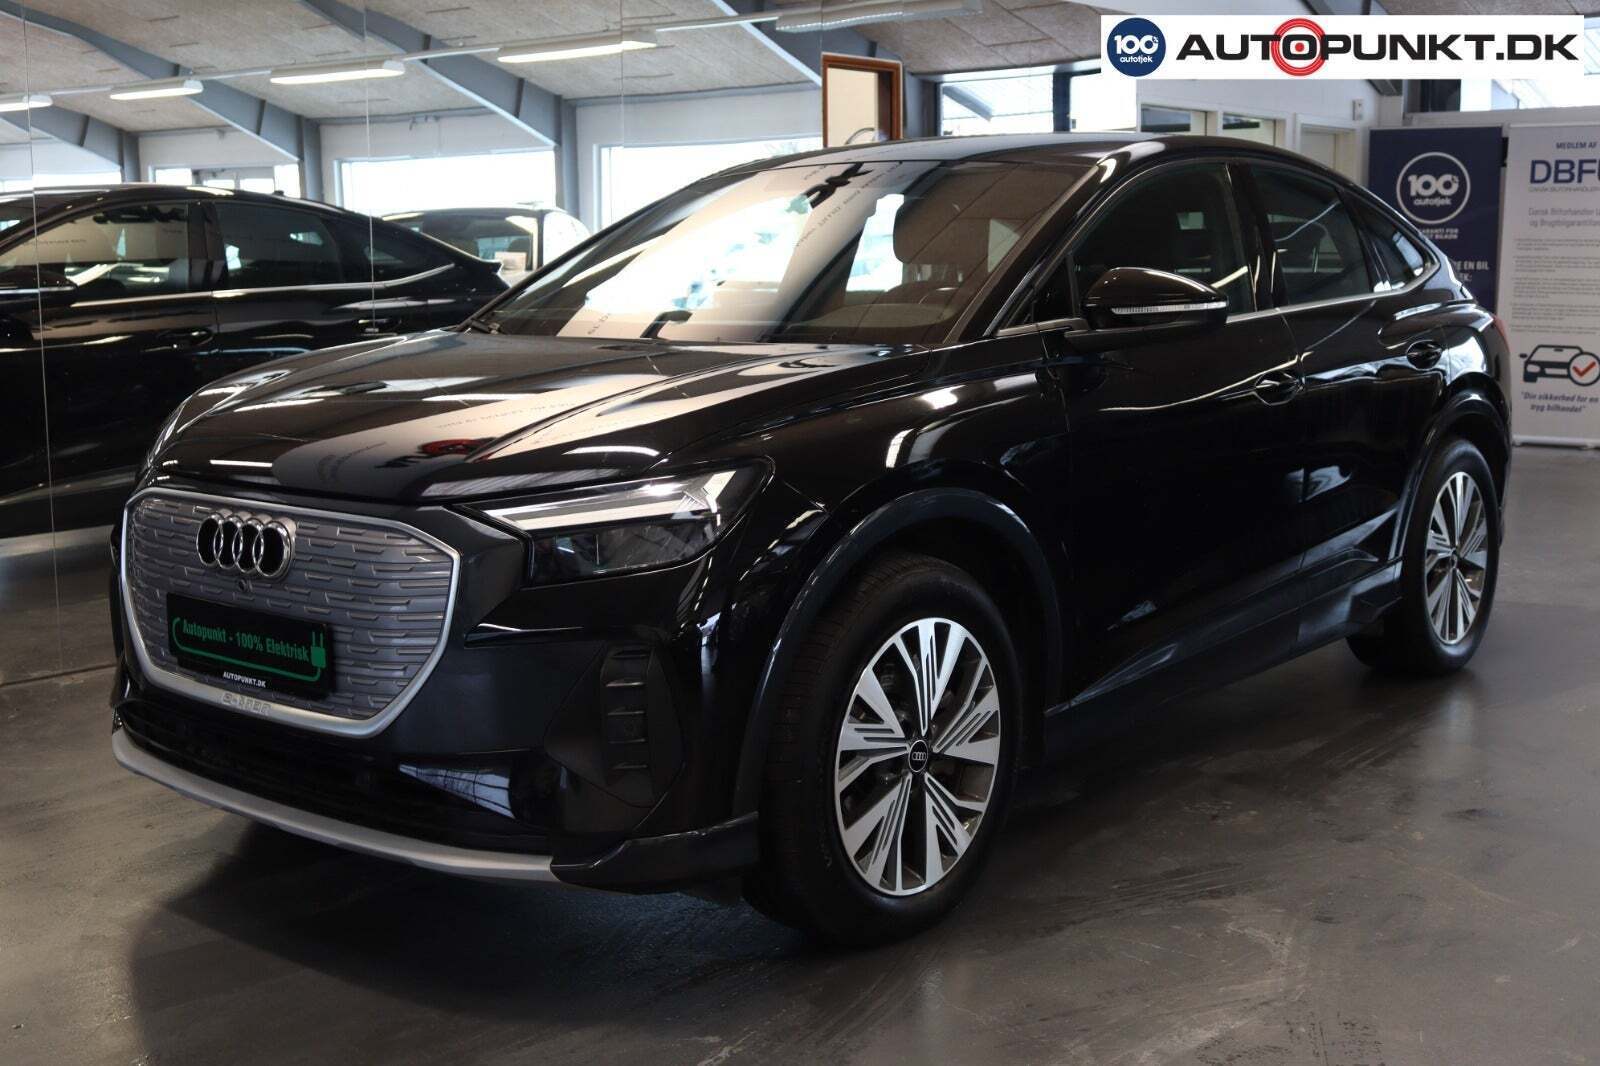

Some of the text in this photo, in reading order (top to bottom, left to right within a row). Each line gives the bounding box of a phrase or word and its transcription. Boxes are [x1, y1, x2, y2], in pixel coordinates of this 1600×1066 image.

[1529, 158, 1600, 185] DBF
[1413, 196, 1452, 207] autotjek
[1538, 392, 1574, 402] sikkerhed
[182, 619, 227, 644] Autopunkt
[236, 631, 264, 653] 100%
[266, 637, 310, 662] Elektrisk
[223, 671, 266, 688] AUTOPUNKT.DK
